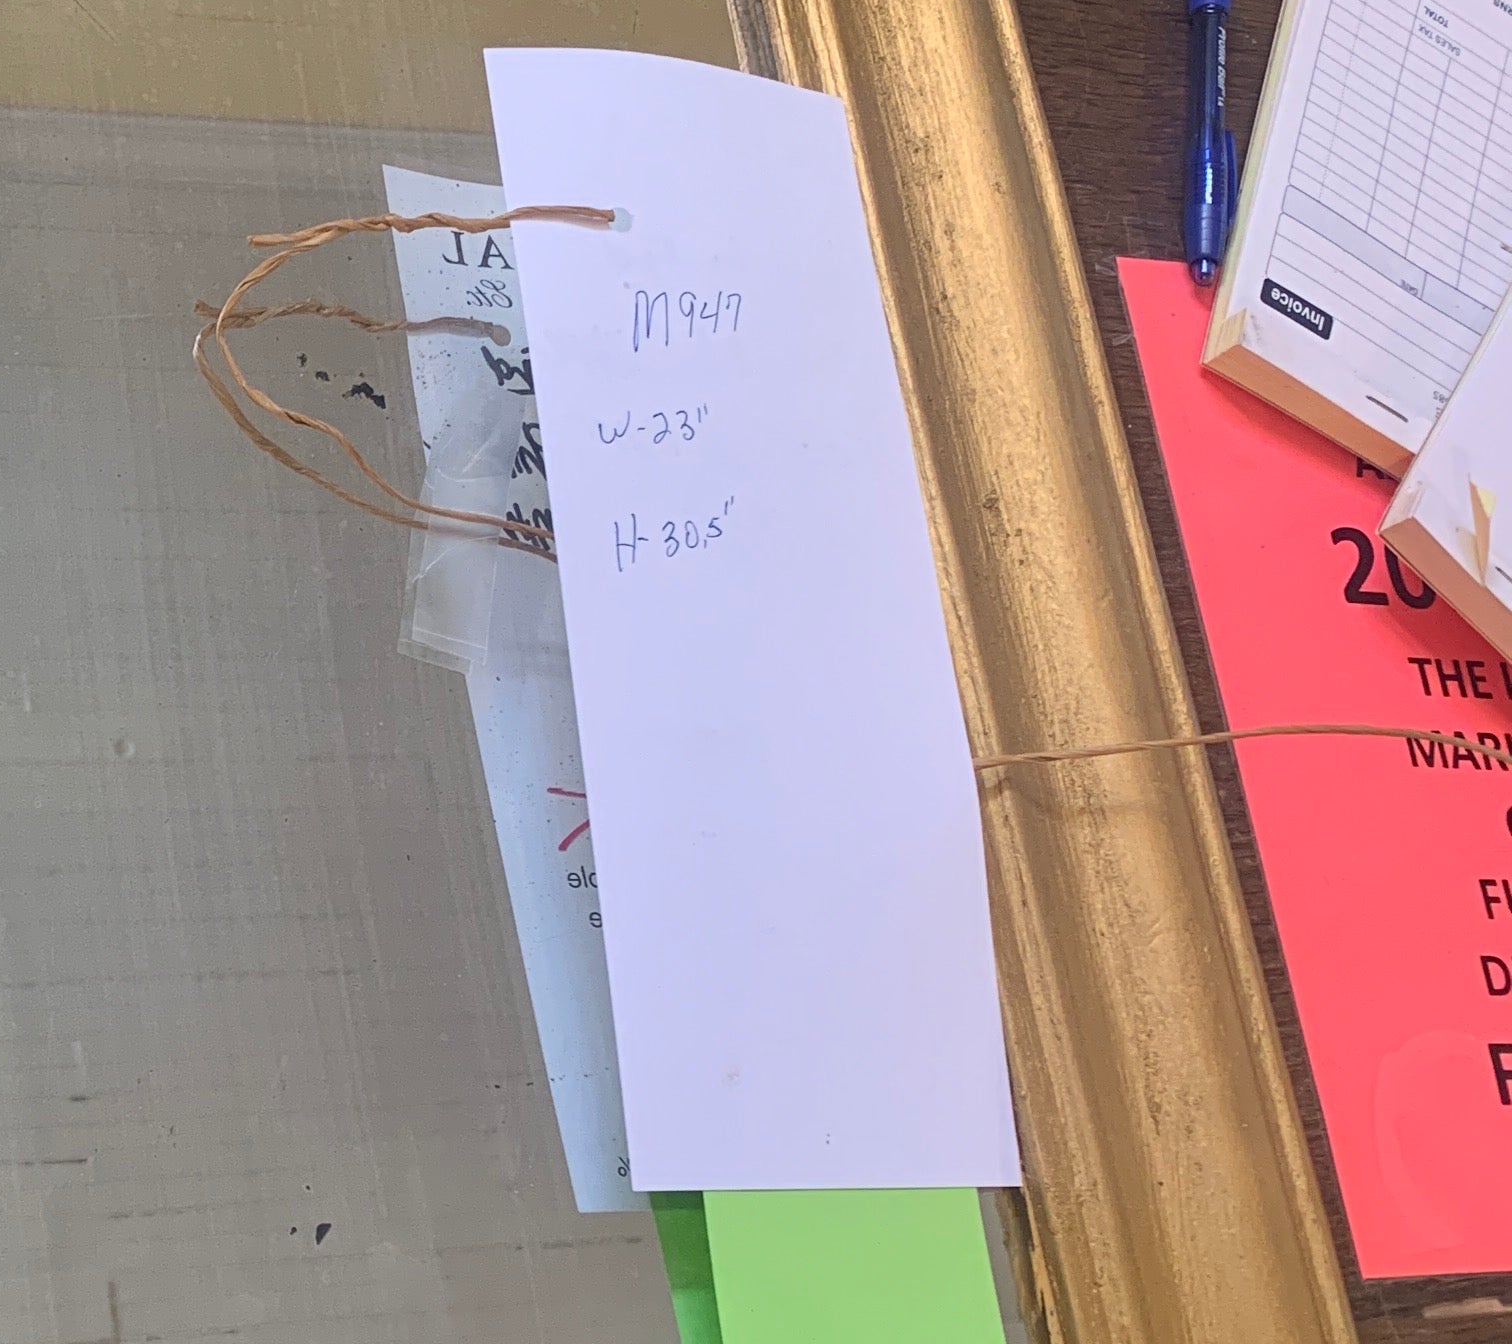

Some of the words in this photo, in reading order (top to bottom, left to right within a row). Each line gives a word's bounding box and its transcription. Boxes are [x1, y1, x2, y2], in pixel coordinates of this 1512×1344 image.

[1424, 5, 1449, 28] TOTAL
[1435, 35, 1461, 56] SALES
[633, 290, 742, 353] M947
[1270, 286, 1325, 331] Invoice
[1407, 657, 1493, 700] THE
